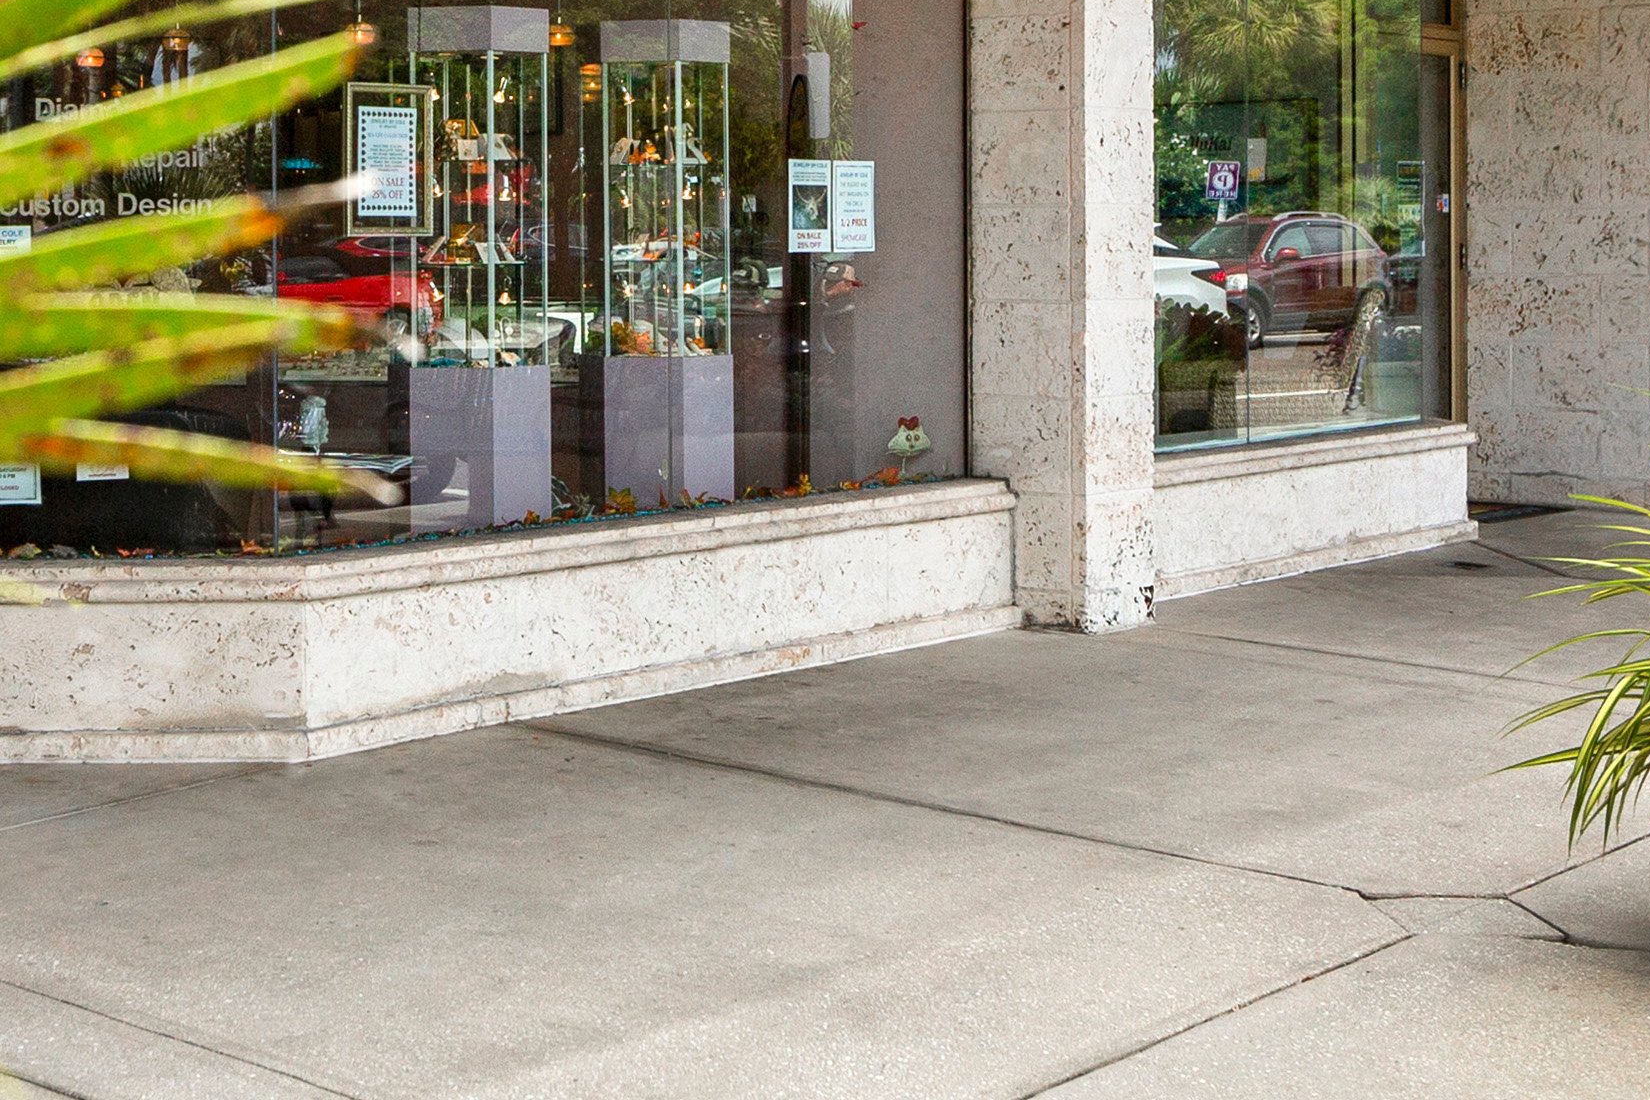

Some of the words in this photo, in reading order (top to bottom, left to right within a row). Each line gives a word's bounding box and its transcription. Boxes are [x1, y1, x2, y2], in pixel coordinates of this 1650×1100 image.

[127, 145, 205, 171] epair
[387, 177, 405, 187] SALE
[388, 190, 404, 200] OFF
